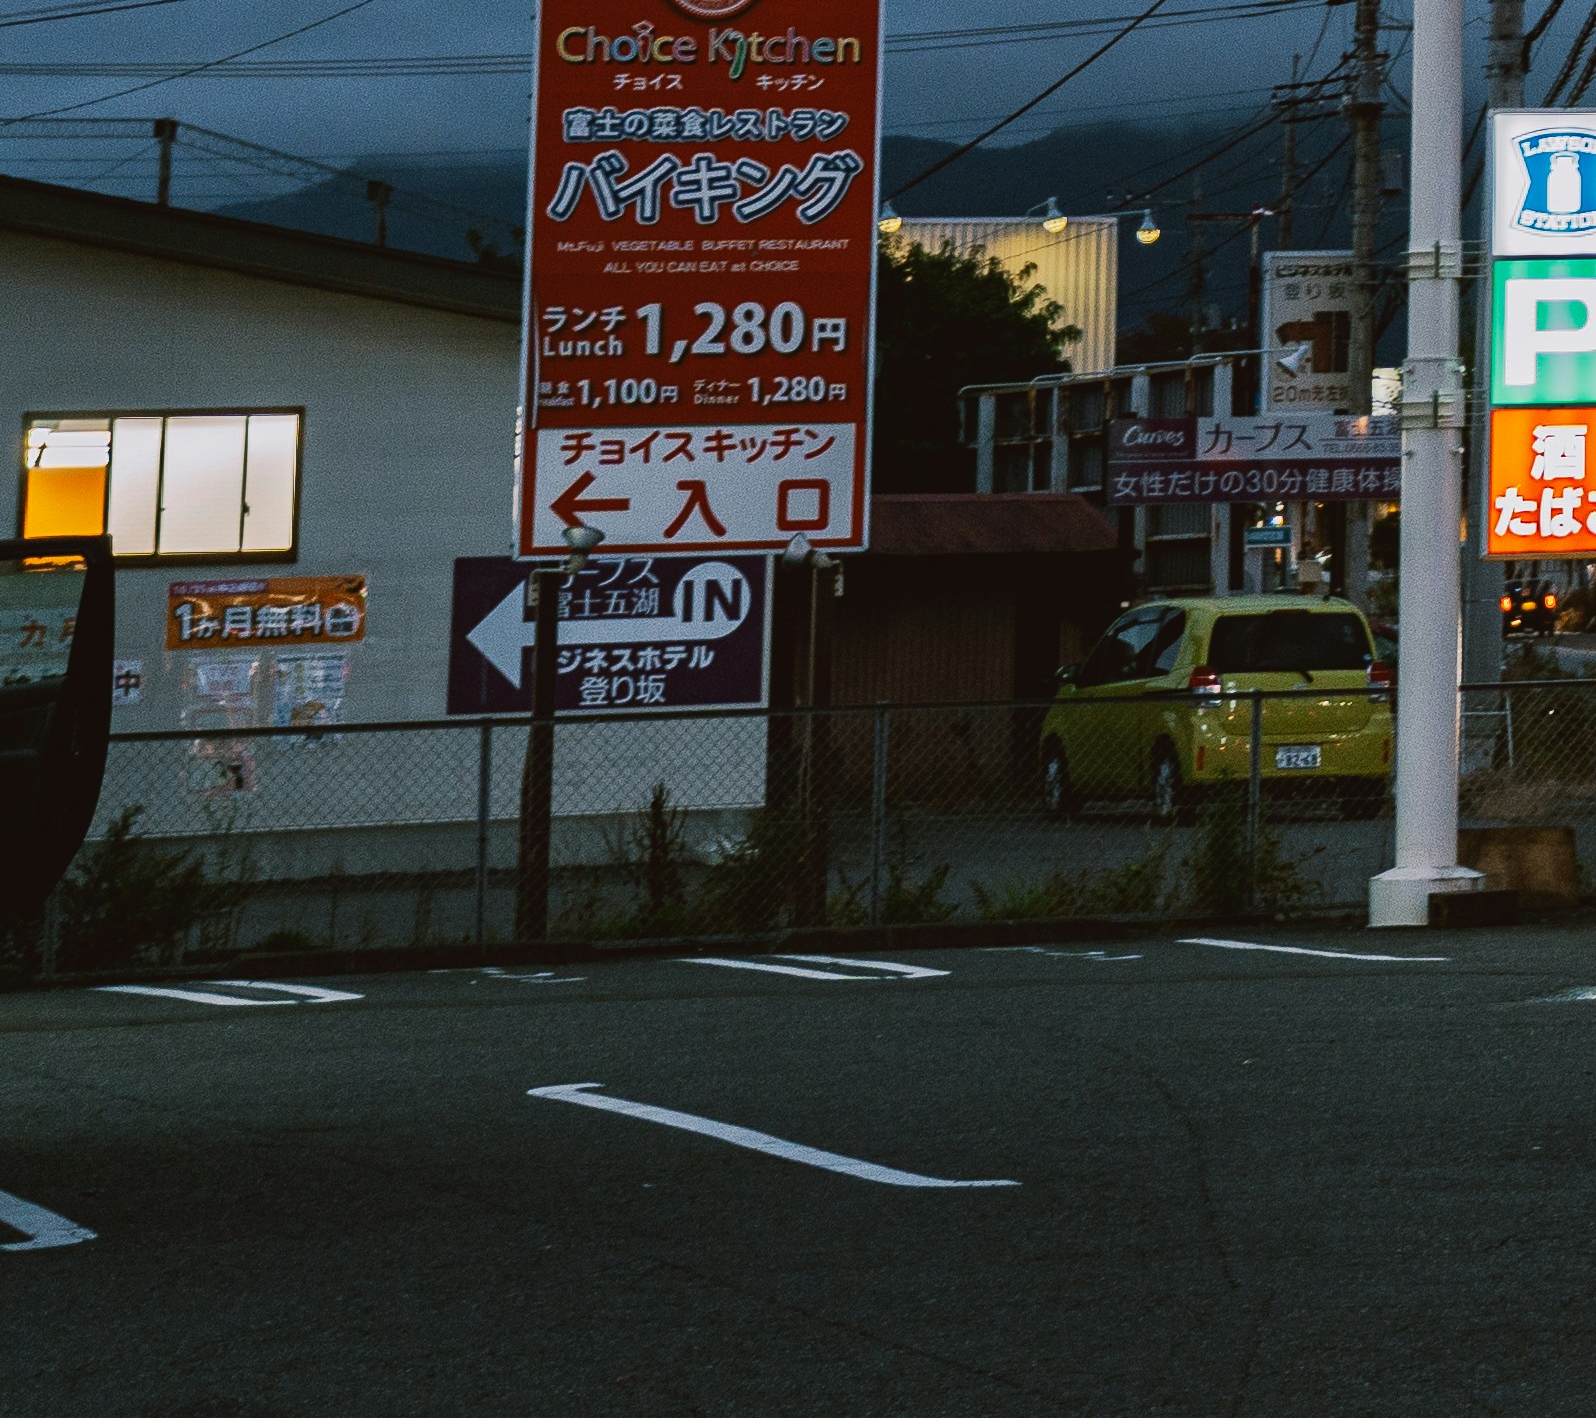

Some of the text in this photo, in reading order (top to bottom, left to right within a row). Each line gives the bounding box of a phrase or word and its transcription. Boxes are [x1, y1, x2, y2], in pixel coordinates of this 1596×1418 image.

[556, 20, 698, 62] Choice
[612, 72, 826, 91] チョイス キッチン
[562, 105, 850, 143] 富士の菜食レストラン
[546, 148, 864, 225] バイキング
[611, 239, 695, 252] VEGETABLE
[700, 238, 756, 252] BUFFET
[758, 238, 850, 251] RESTAURANT
[603, 261, 632, 274] ALL
[636, 260, 664, 273] YOU
[667, 260, 698, 273] CAN
[699, 260, 729, 272] EAT
[749, 259, 801, 272] CHOICE
[542, 305, 627, 333] ランチ
[542, 334, 624, 357] Lunch
[560, 426, 837, 466] チョイスキッチン
[1122, 424, 1185, 448] Curves
[1530, 424, 1588, 481] 酒
[662, 478, 832, 540] 入口
[681, 578, 742, 623] IN
[557, 645, 716, 675] ジネスホテル
[578, 674, 668, 706] 登り坂
